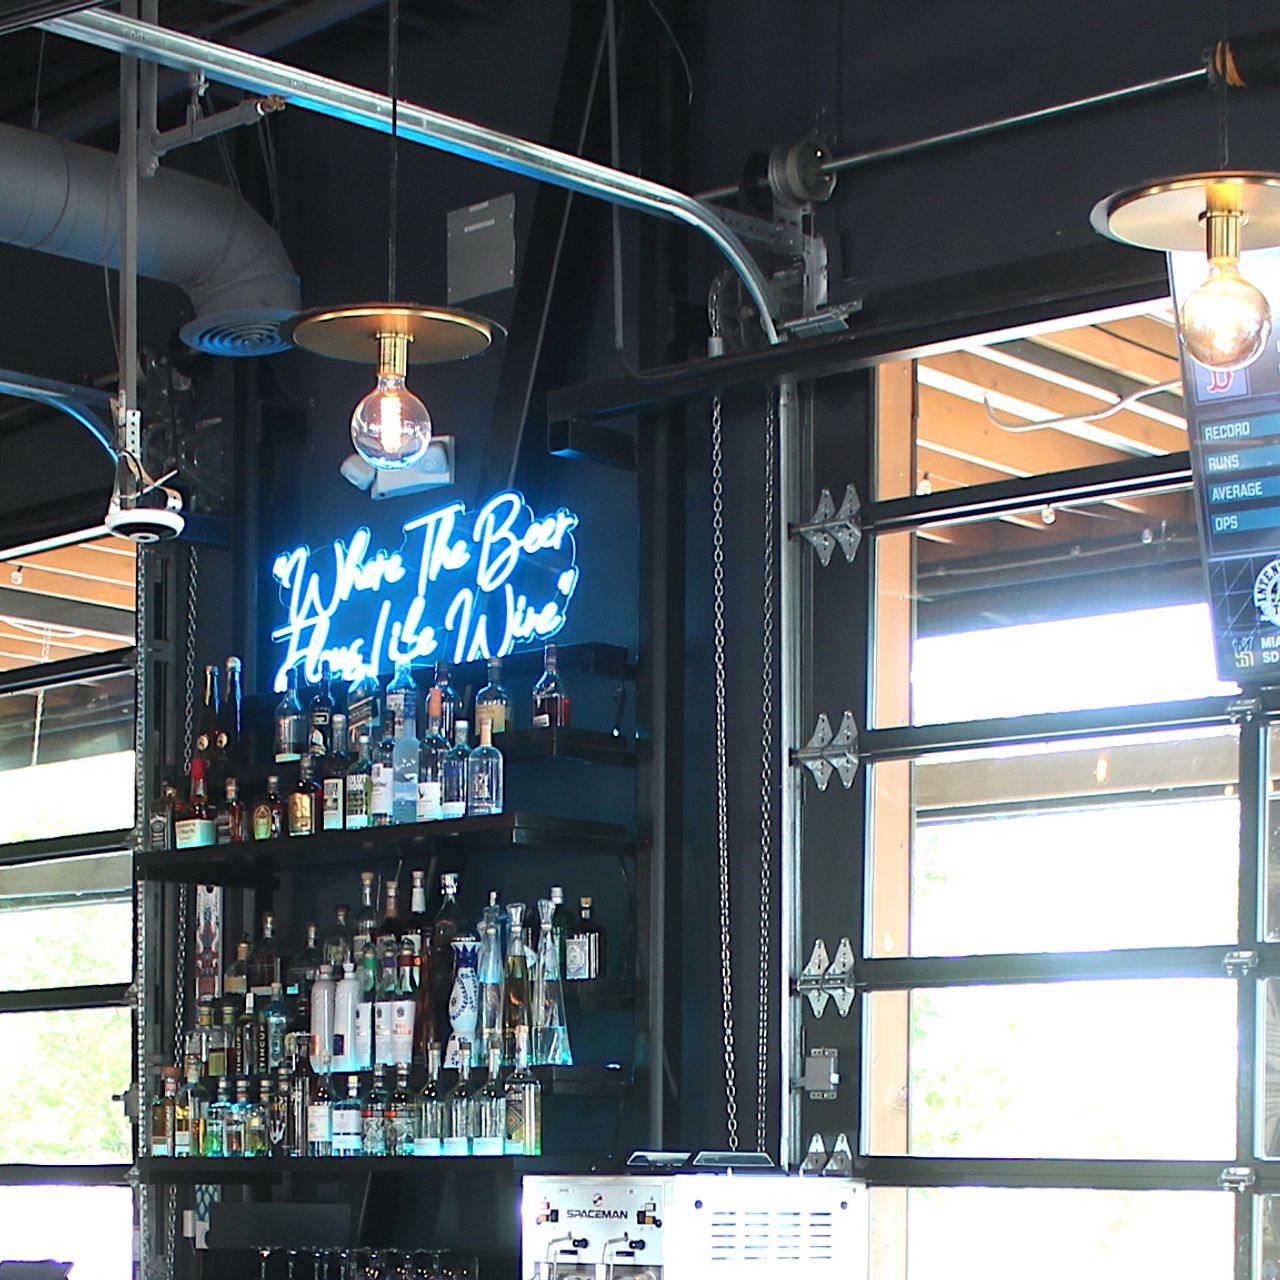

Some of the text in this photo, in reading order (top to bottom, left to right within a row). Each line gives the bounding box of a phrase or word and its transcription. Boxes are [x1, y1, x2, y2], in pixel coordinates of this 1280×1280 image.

[1205, 421, 1251, 441] RECORD
[1207, 455, 1240, 471] RUNS
[1211, 482, 1263, 501] AVERAGE
[1215, 516, 1238, 531] OPS
[405, 500, 470, 597] The
[473, 490, 578, 592] Beer
[368, 595, 438, 680] Like
[1262, 653, 1280, 664] SD
[567, 1209, 628, 1219] SPACEMAN
